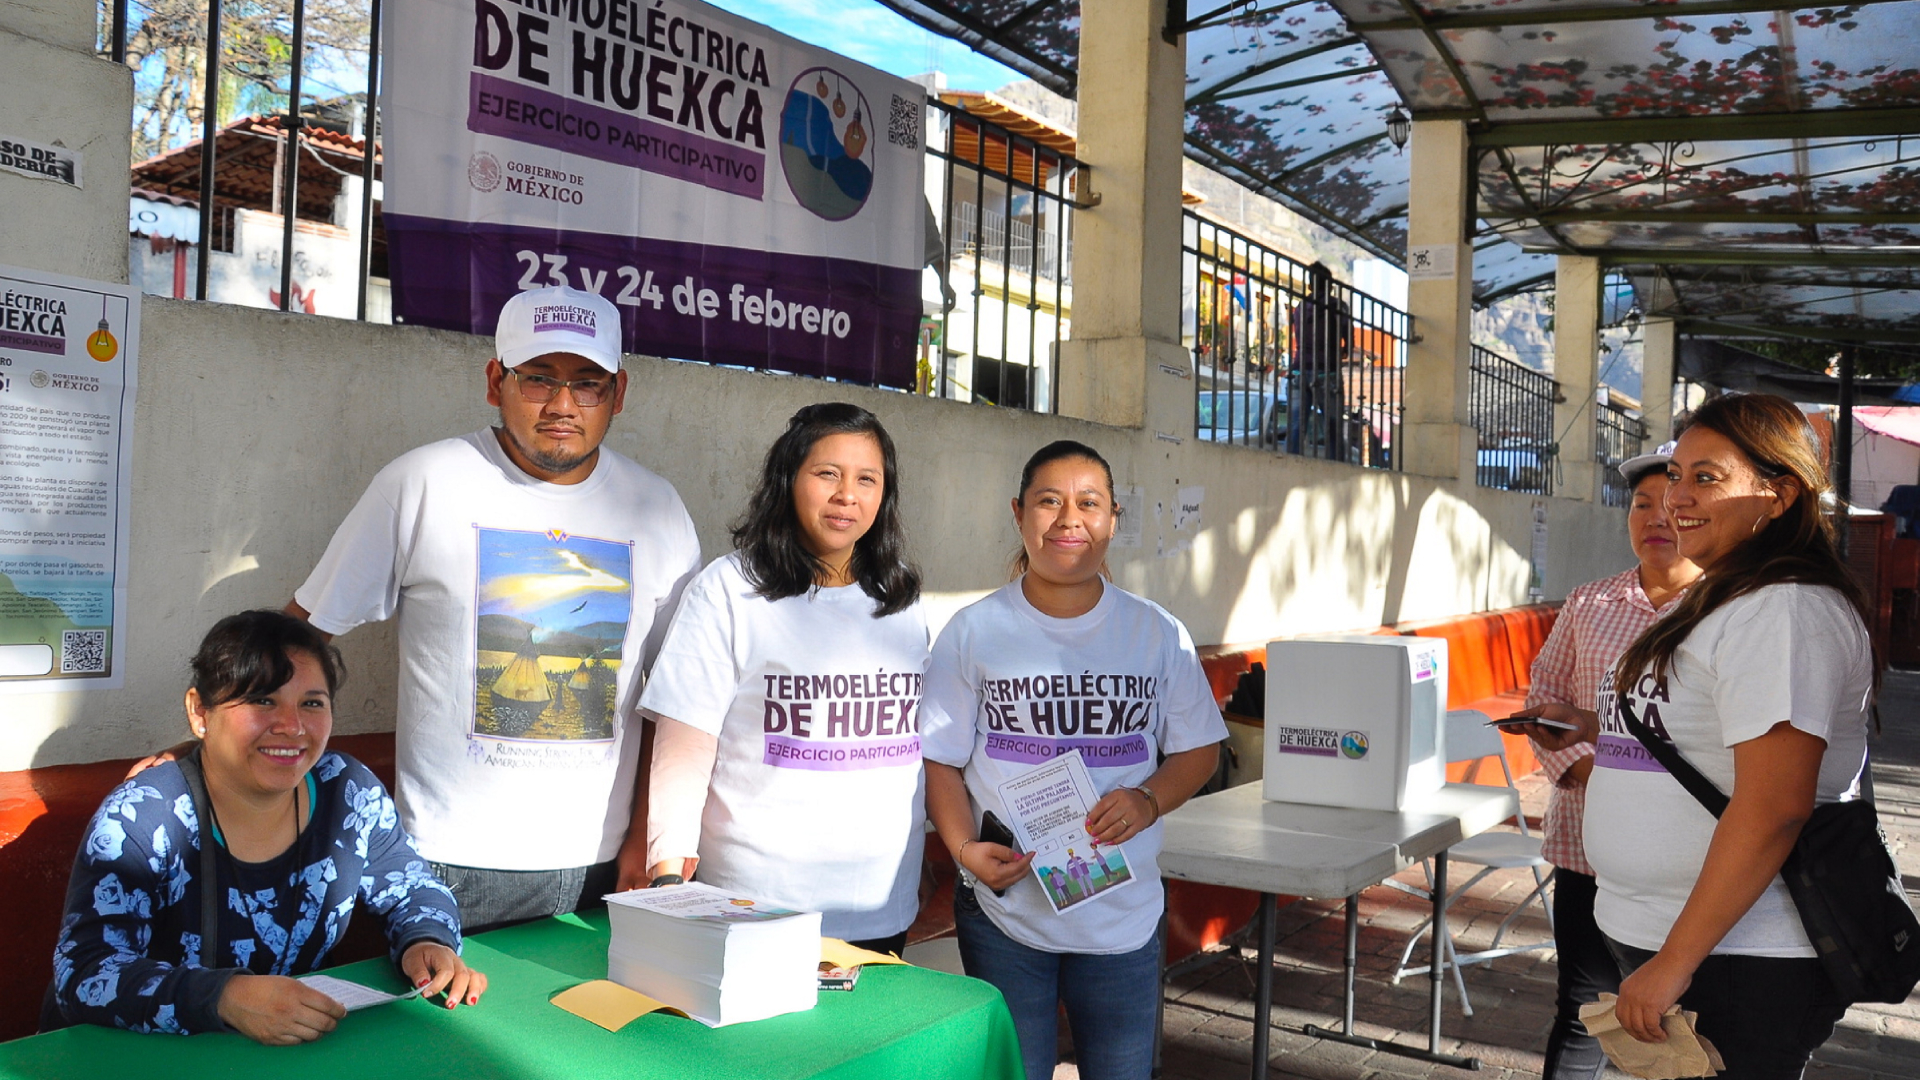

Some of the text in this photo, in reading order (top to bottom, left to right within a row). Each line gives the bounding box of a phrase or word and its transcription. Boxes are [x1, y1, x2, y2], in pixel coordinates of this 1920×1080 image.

[505, 0, 769, 87] MOELÉCTRICA
[473, 0, 766, 149] DE HUEXCA
[478, 91, 757, 184] EJERCICIO PARTICIPATIVO
[31, 147, 56, 164] DE
[507, 161, 584, 186] GOBIERNO DE
[505, 176, 583, 205] MÉXICO
[516, 249, 569, 290] 23
[616, 266, 664, 310] 24
[672, 276, 720, 318] de
[729, 283, 850, 338] febrero
[534, 305, 597, 318] TERMOELÉCTRICA
[534, 312, 596, 328] DE HUEXCA
[52, 373, 89, 382] GOBIERNO
[52, 380, 99, 392] MÉXICO
[9, 412, 28, 420] 2009
[40, 416, 73, 424] construyó
[83, 412, 110, 420] produce
[2, 420, 35, 428] suficiente
[38, 423, 67, 431] generará
[27, 453, 64, 462] energético
[75, 449, 108, 458] tecnología
[22, 484, 57, 492] residuales
[68, 478, 97, 486] disponer
[31, 492, 64, 500] integrada
[67, 501, 107, 509] productores
[32, 537, 58, 546] energía
[72, 532, 105, 540] propiedad
[764, 668, 923, 700] TERMOELÉCTR
[764, 699, 919, 738] DE HUEX
[984, 699, 1152, 736] DE HUEXCA
[1280, 726, 1338, 738] TERMOELÉCTRICA
[987, 736, 1051, 757] EJERCICIO
[1280, 734, 1338, 748] DE HUEXCA
[768, 742, 845, 761] EJERCICIO
[1045, 784, 1073, 800] PALABRA,
[1020, 809, 1030, 817] POR
[1041, 791, 1075, 808] PREGUNTAMOS
